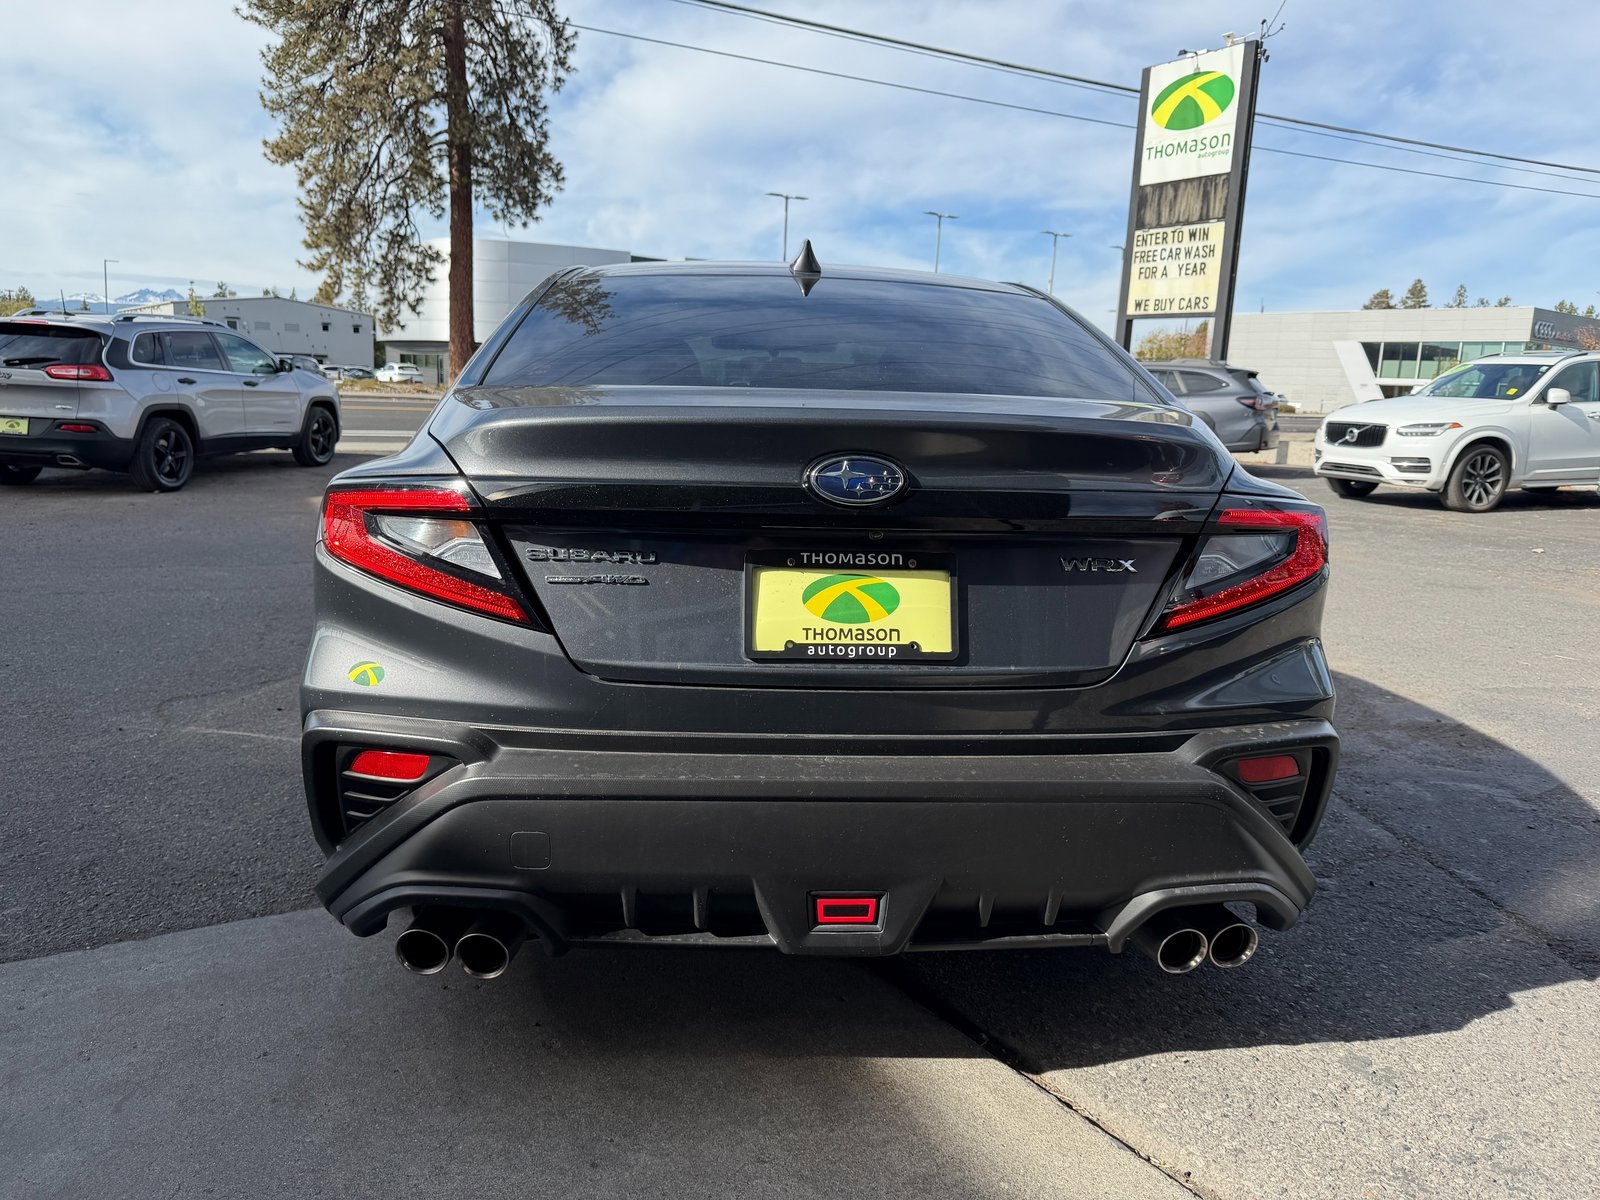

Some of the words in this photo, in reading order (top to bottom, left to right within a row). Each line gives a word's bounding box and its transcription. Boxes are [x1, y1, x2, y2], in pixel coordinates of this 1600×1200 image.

[1197, 149, 1230, 159] autogroup
[1135, 231, 1168, 247] ENTER
[1171, 230, 1184, 243] TO
[1188, 227, 1209, 242] WIN
[1134, 249, 1158, 264] FREE
[1160, 247, 1181, 261] CAR
[1184, 244, 1215, 259] WASH
[1138, 266, 1157, 280] FOR
[1161, 265, 1168, 278] A
[1178, 262, 1206, 277] YEAR
[1135, 299, 1150, 312] WE
[1153, 297, 1175, 311] BUY
[1178, 296, 1209, 311] CARS
[525, 548, 657, 563] SUBARU
[1060, 557, 1138, 573] WRX
[807, 644, 897, 658] autogroup
